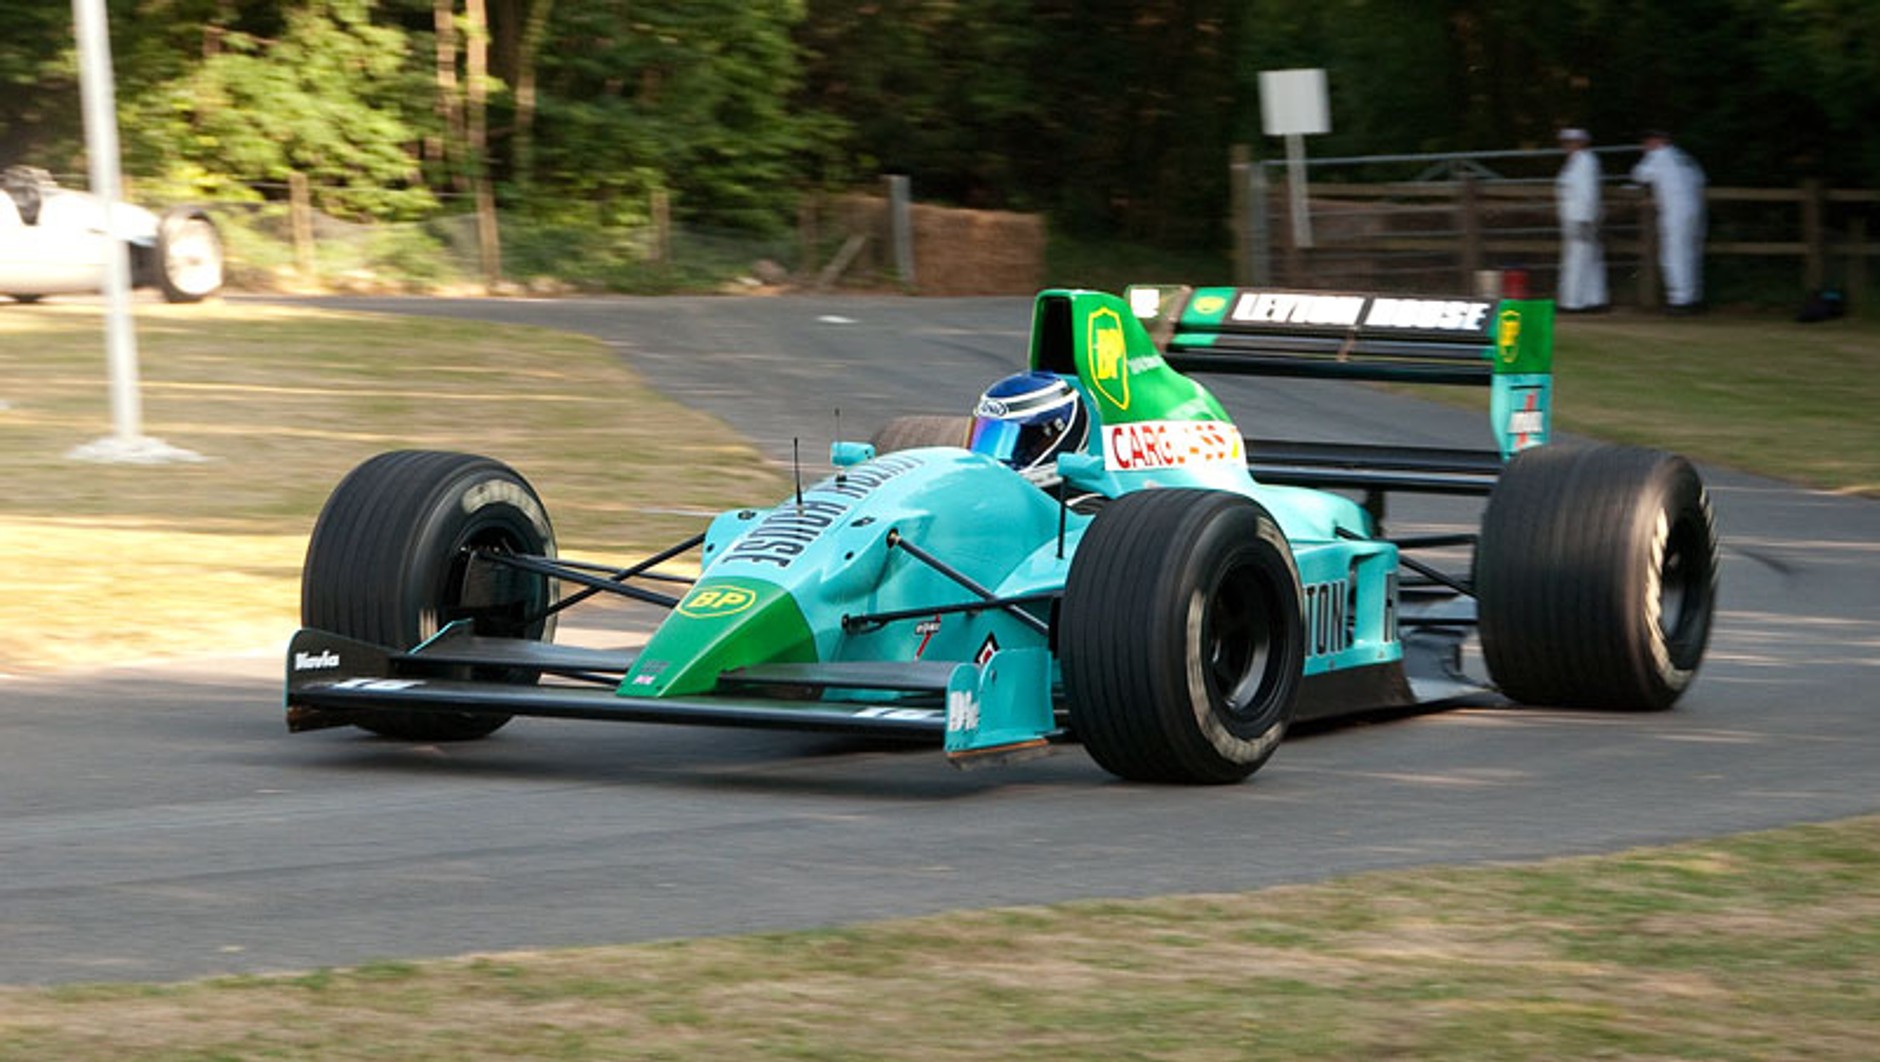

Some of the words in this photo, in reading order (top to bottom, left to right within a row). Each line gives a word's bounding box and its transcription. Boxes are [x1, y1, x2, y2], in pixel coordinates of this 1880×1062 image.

[1232, 293, 1365, 325] LEYTON
[1365, 298, 1491, 331] HOUSE
[1097, 329, 1123, 379] BP
[1111, 426, 1226, 468] CARGSS
[722, 500, 847, 567] HOUSE
[687, 592, 745, 608] BP
